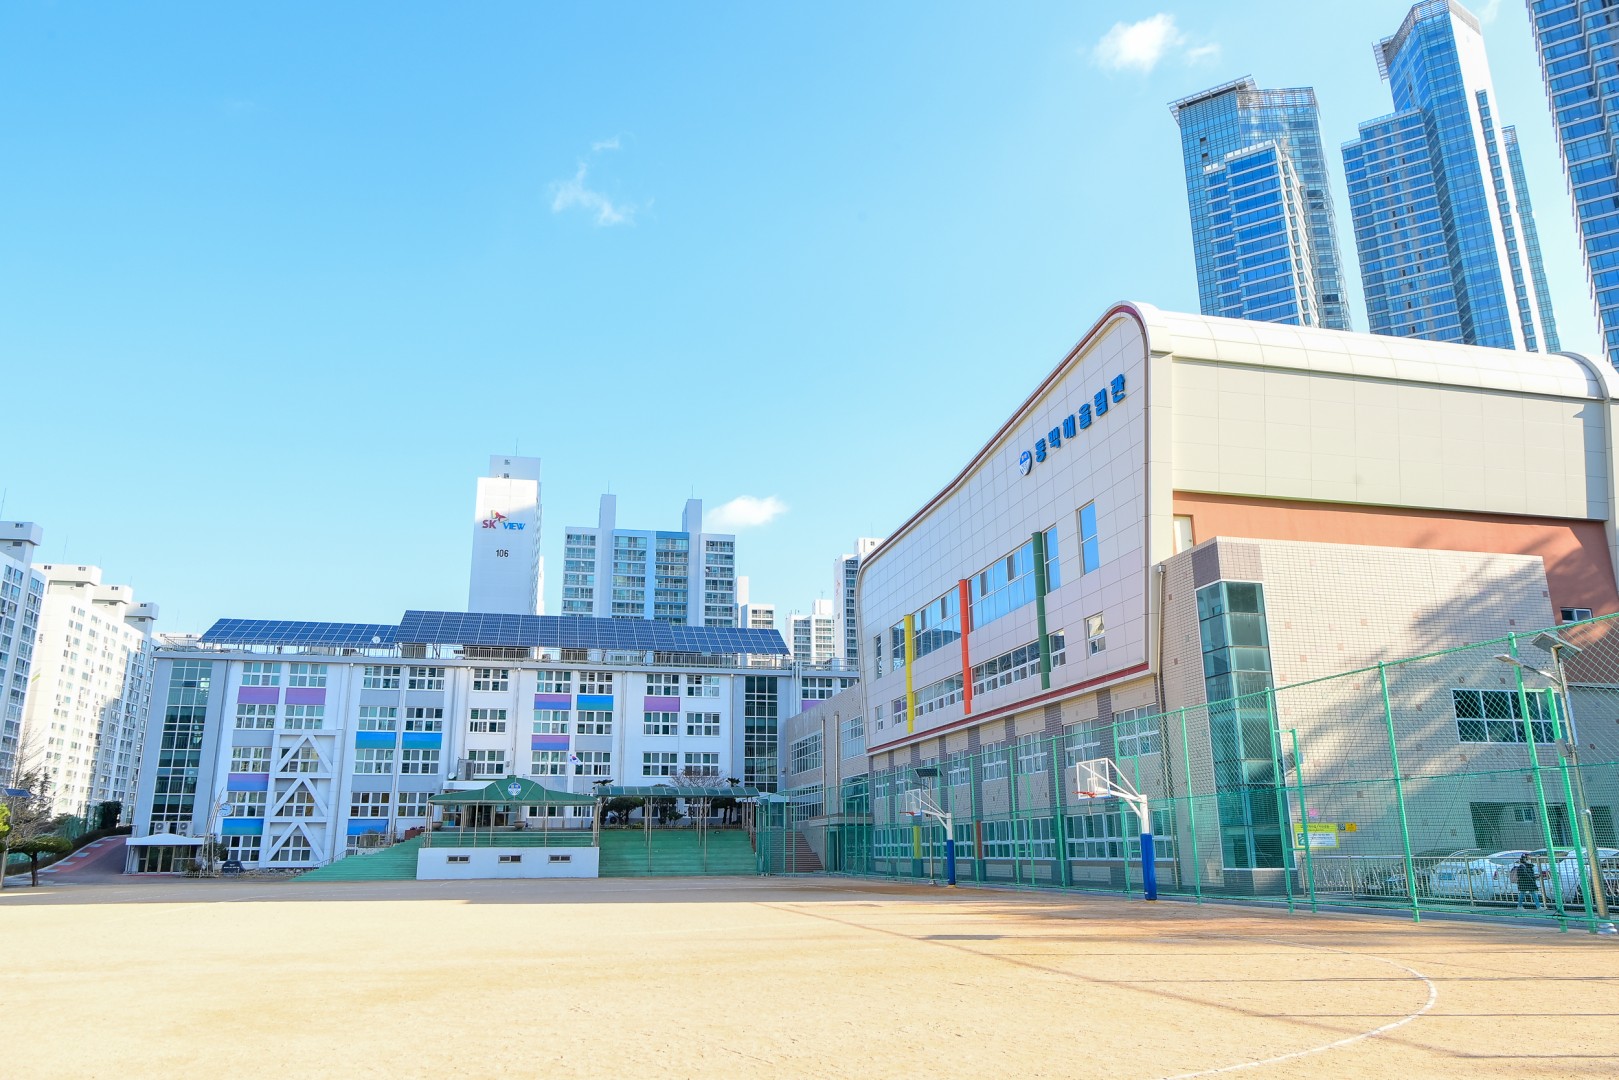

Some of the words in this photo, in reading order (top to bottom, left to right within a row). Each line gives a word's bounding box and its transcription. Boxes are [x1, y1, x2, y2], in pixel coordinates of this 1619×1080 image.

[482, 519, 497, 529] SK
[503, 522, 526, 530] VIEW
[496, 549, 509, 558] 106
